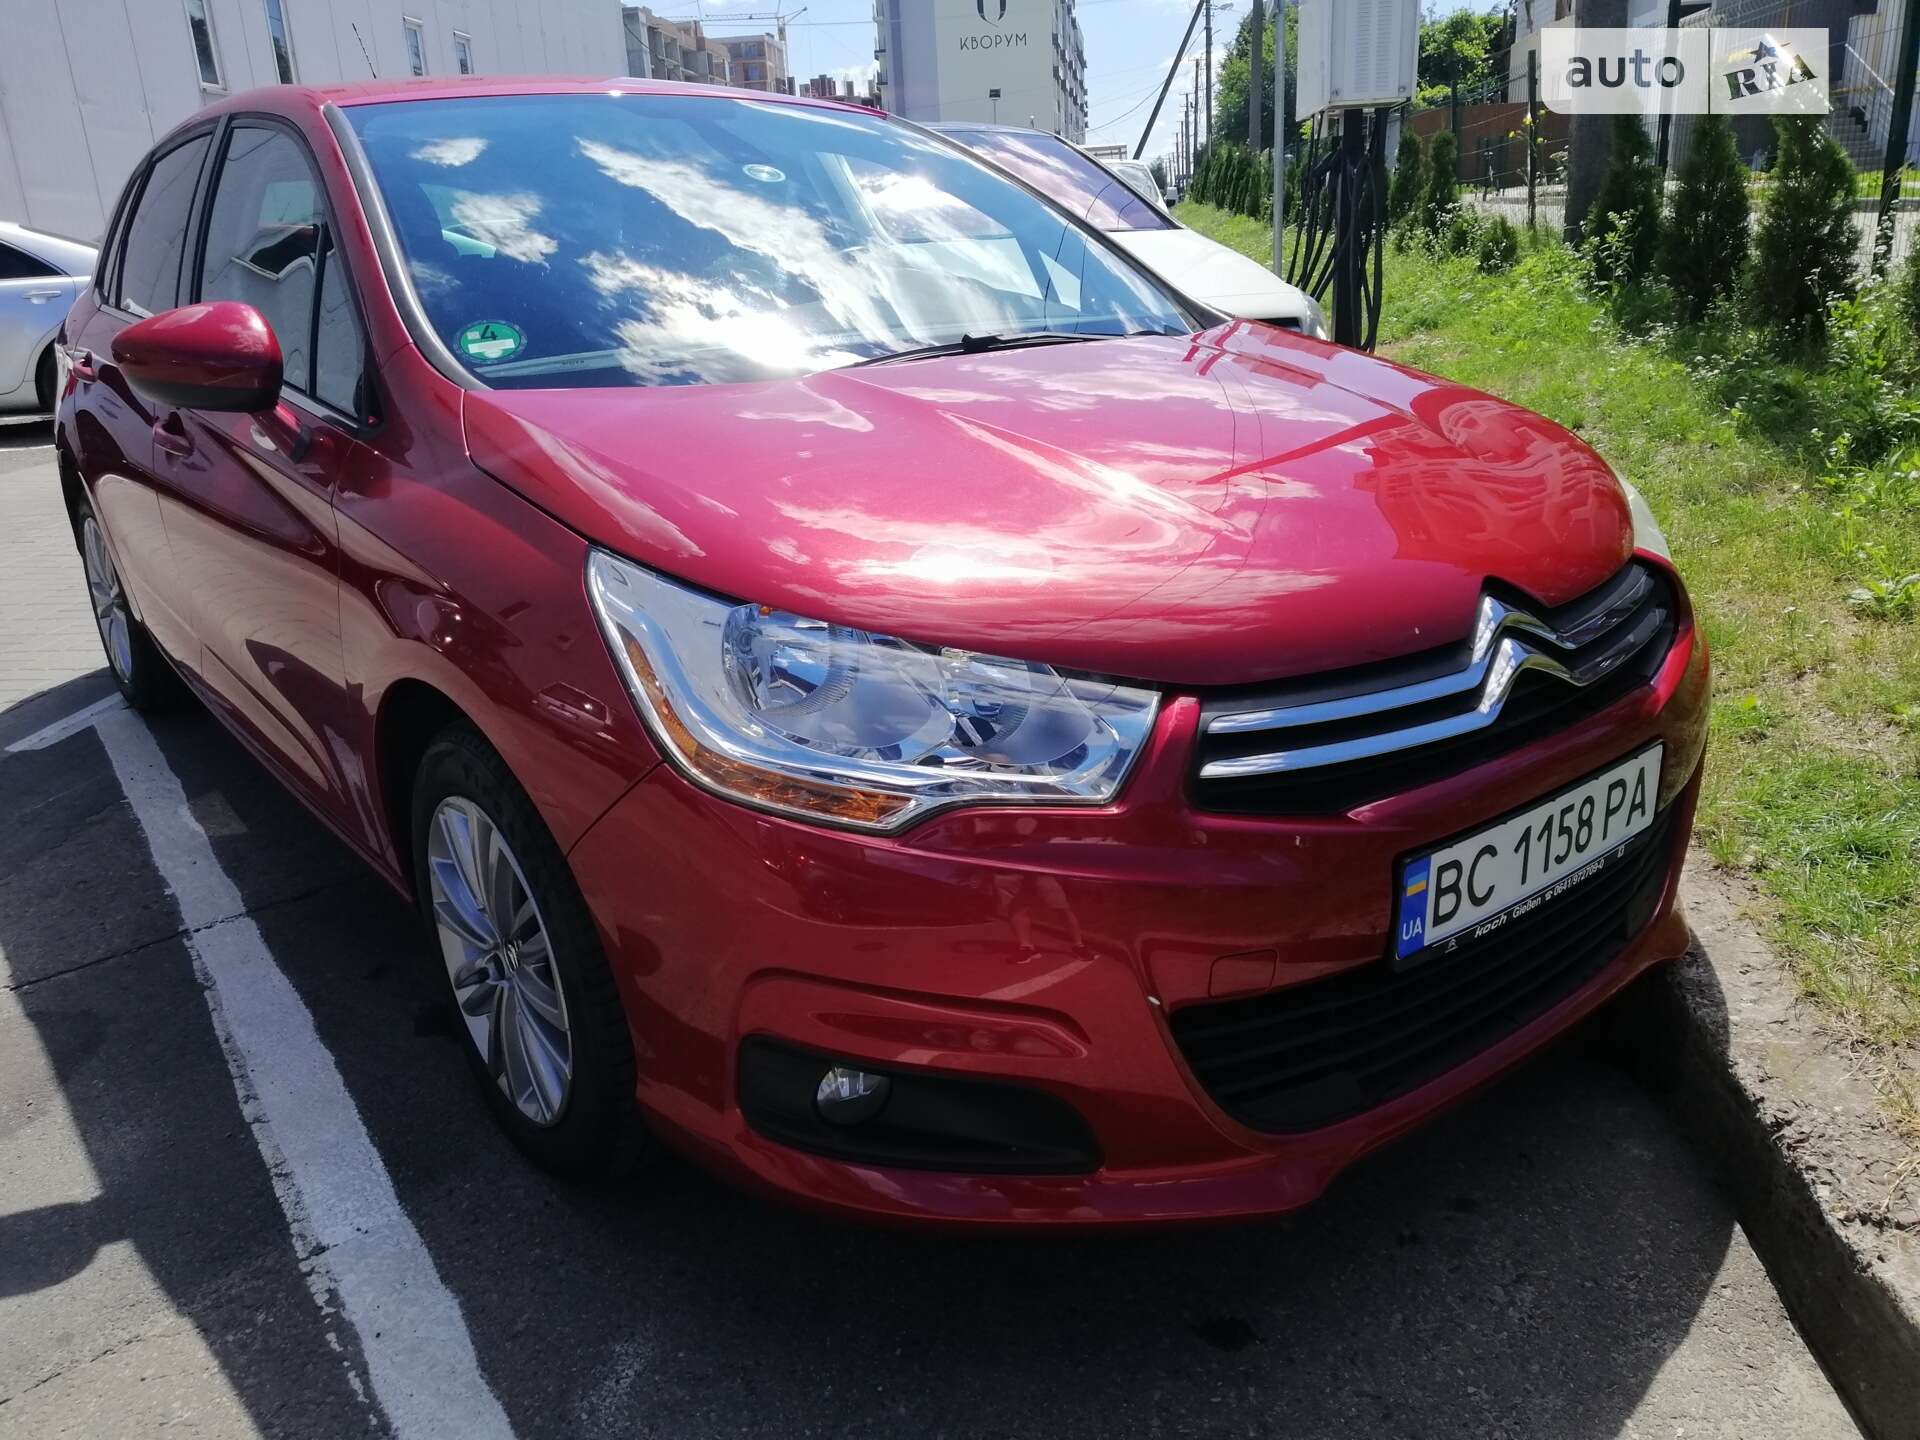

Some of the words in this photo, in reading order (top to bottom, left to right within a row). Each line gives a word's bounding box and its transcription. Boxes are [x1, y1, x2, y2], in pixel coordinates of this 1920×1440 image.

[960, 32, 1027, 51] КВОРУМ
[480, 324, 498, 341] 4
[1432, 844, 1498, 929] BC
[1514, 795, 1595, 886] 1158
[1602, 766, 1646, 841] PA
[1402, 916, 1423, 941] UA
